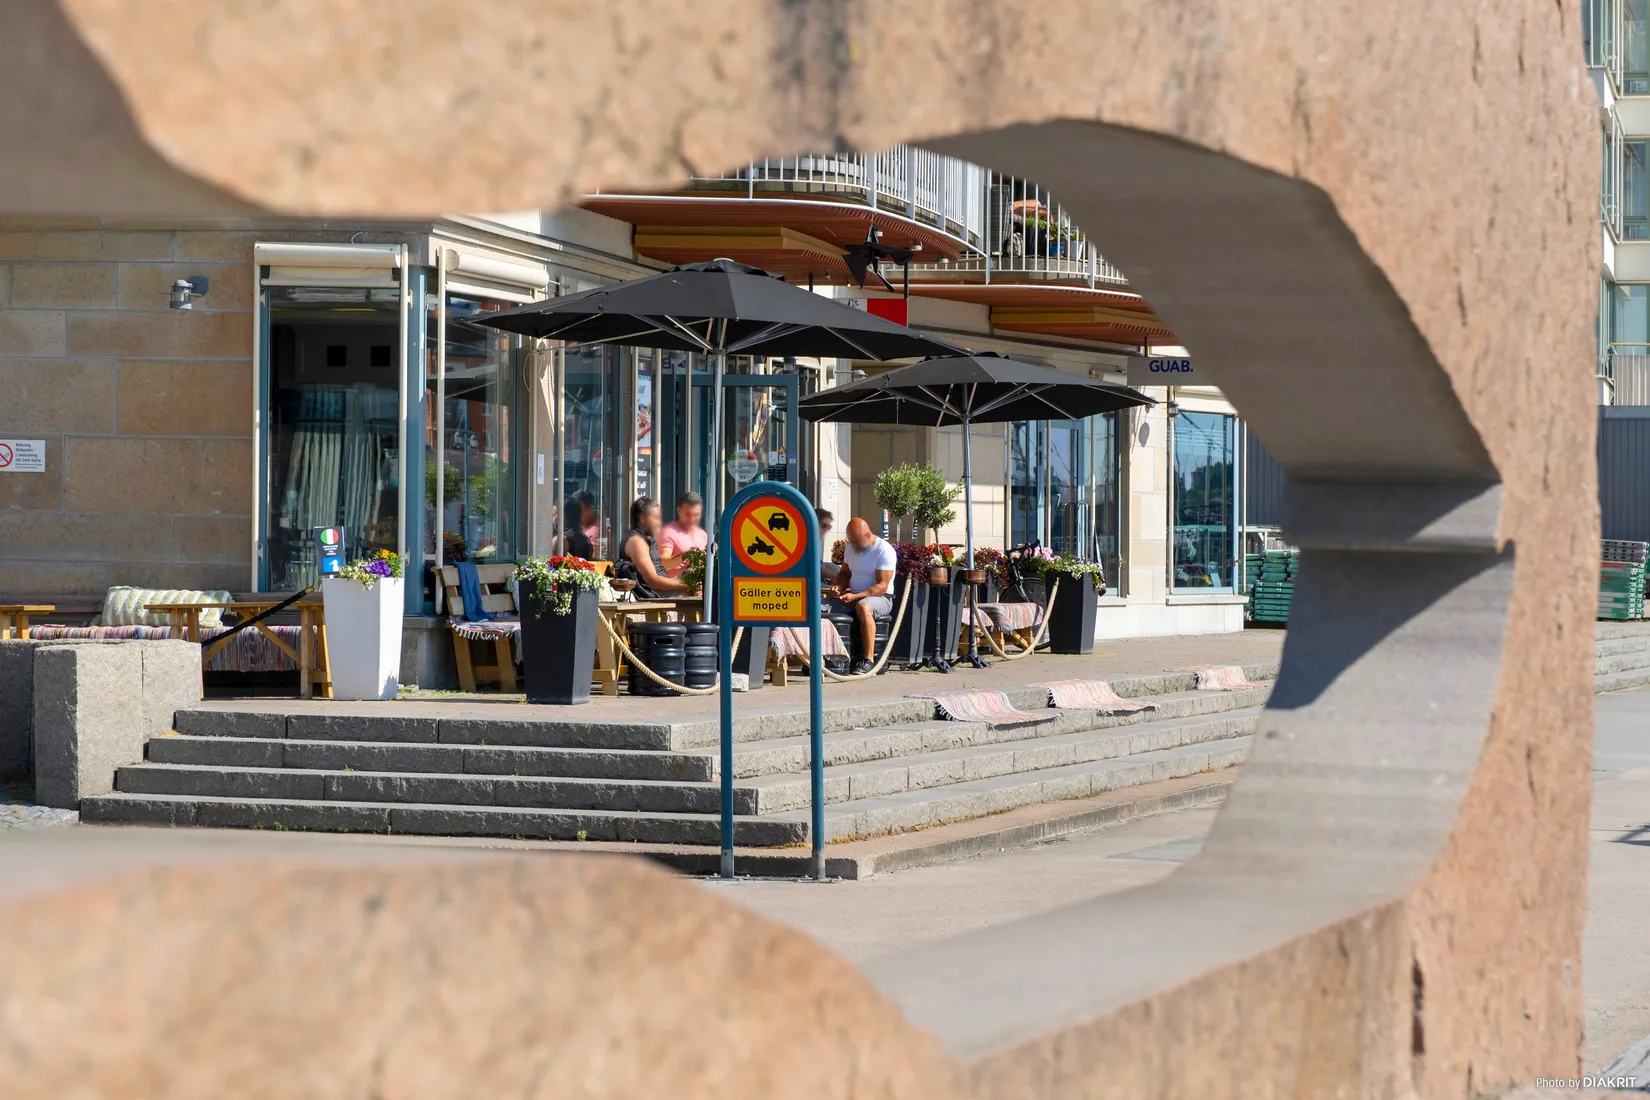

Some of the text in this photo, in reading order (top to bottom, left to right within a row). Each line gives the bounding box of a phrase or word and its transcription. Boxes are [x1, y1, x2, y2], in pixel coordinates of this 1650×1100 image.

[740, 588, 801, 598] Gäller även
[752, 601, 788, 612] moped
